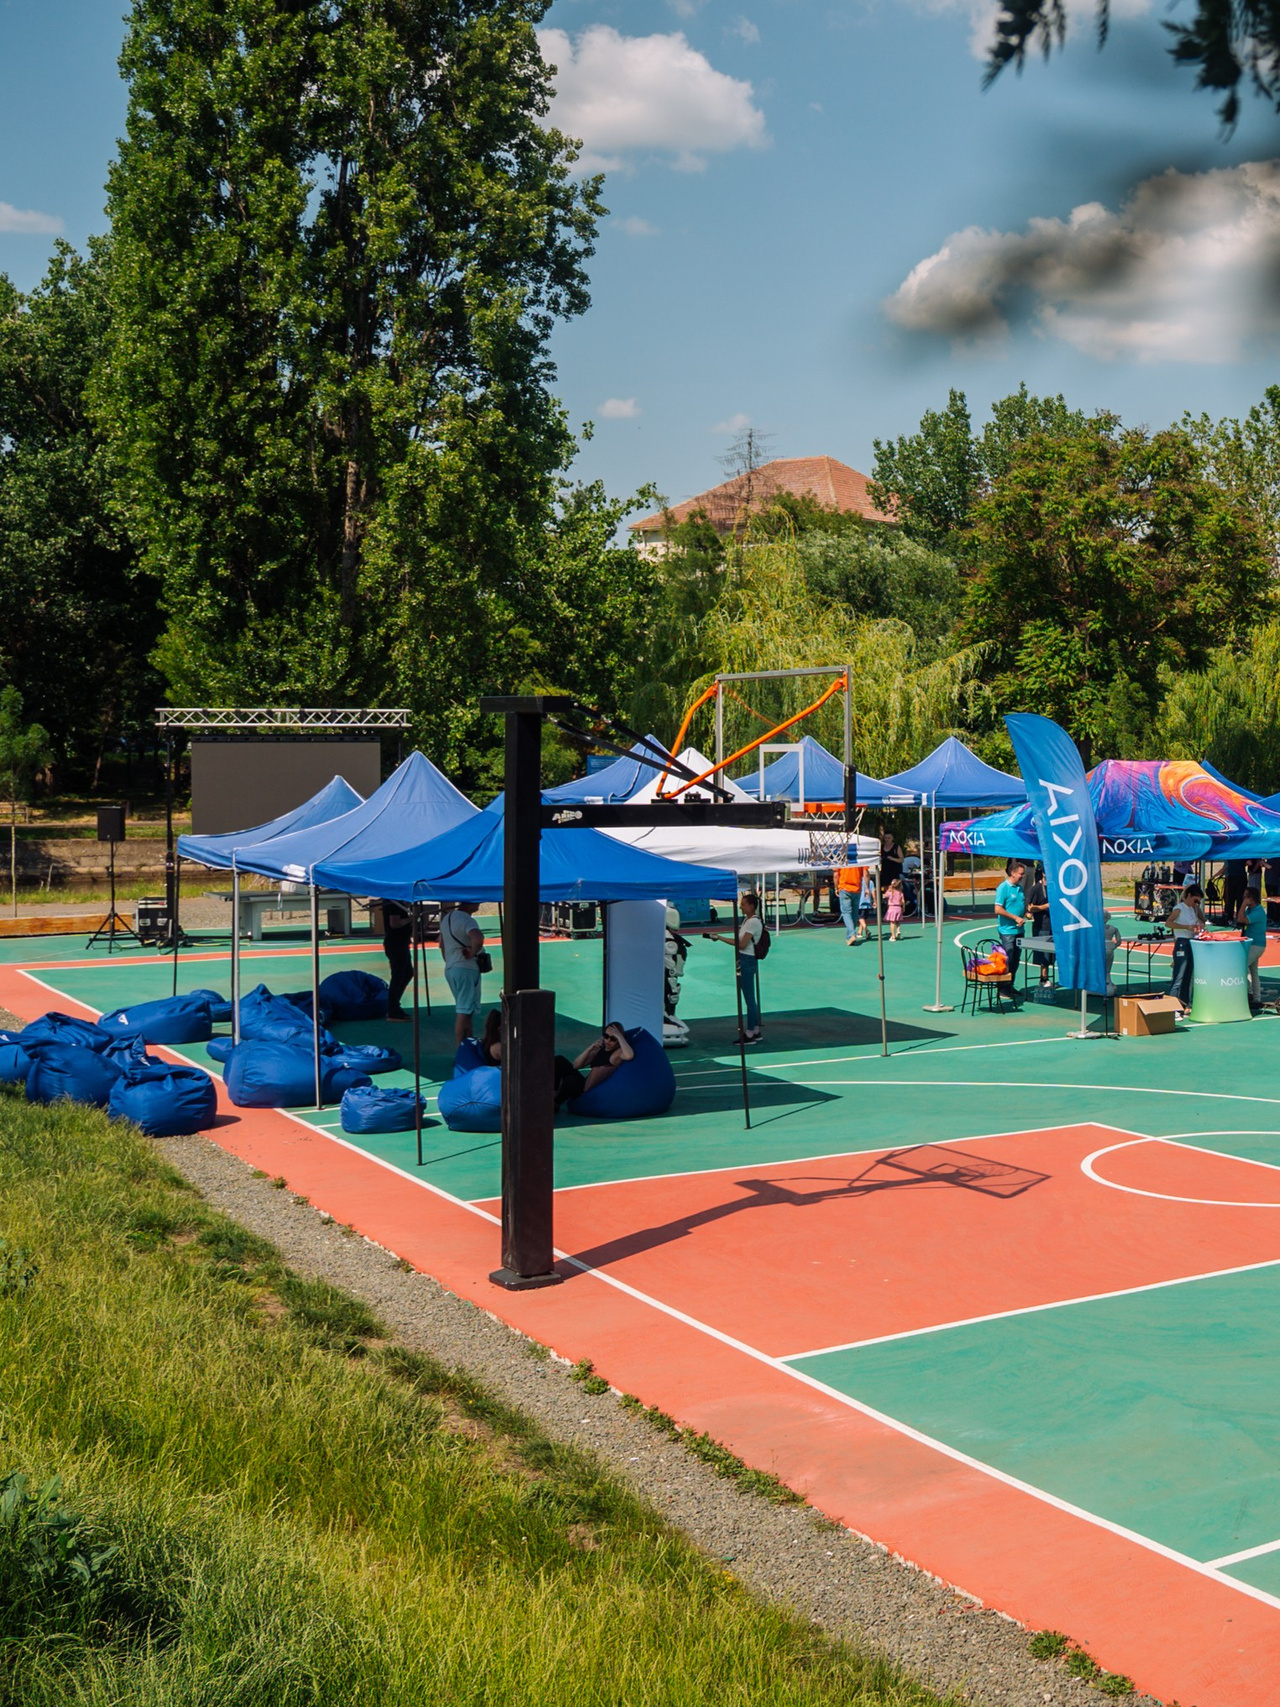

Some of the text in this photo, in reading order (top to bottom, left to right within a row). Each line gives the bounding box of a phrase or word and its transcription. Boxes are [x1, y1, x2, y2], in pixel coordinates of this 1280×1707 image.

[950, 830, 986, 847] NOKIA
[1102, 839, 1154, 854] NOKIA
[1220, 977, 1245, 986] NOKIA
